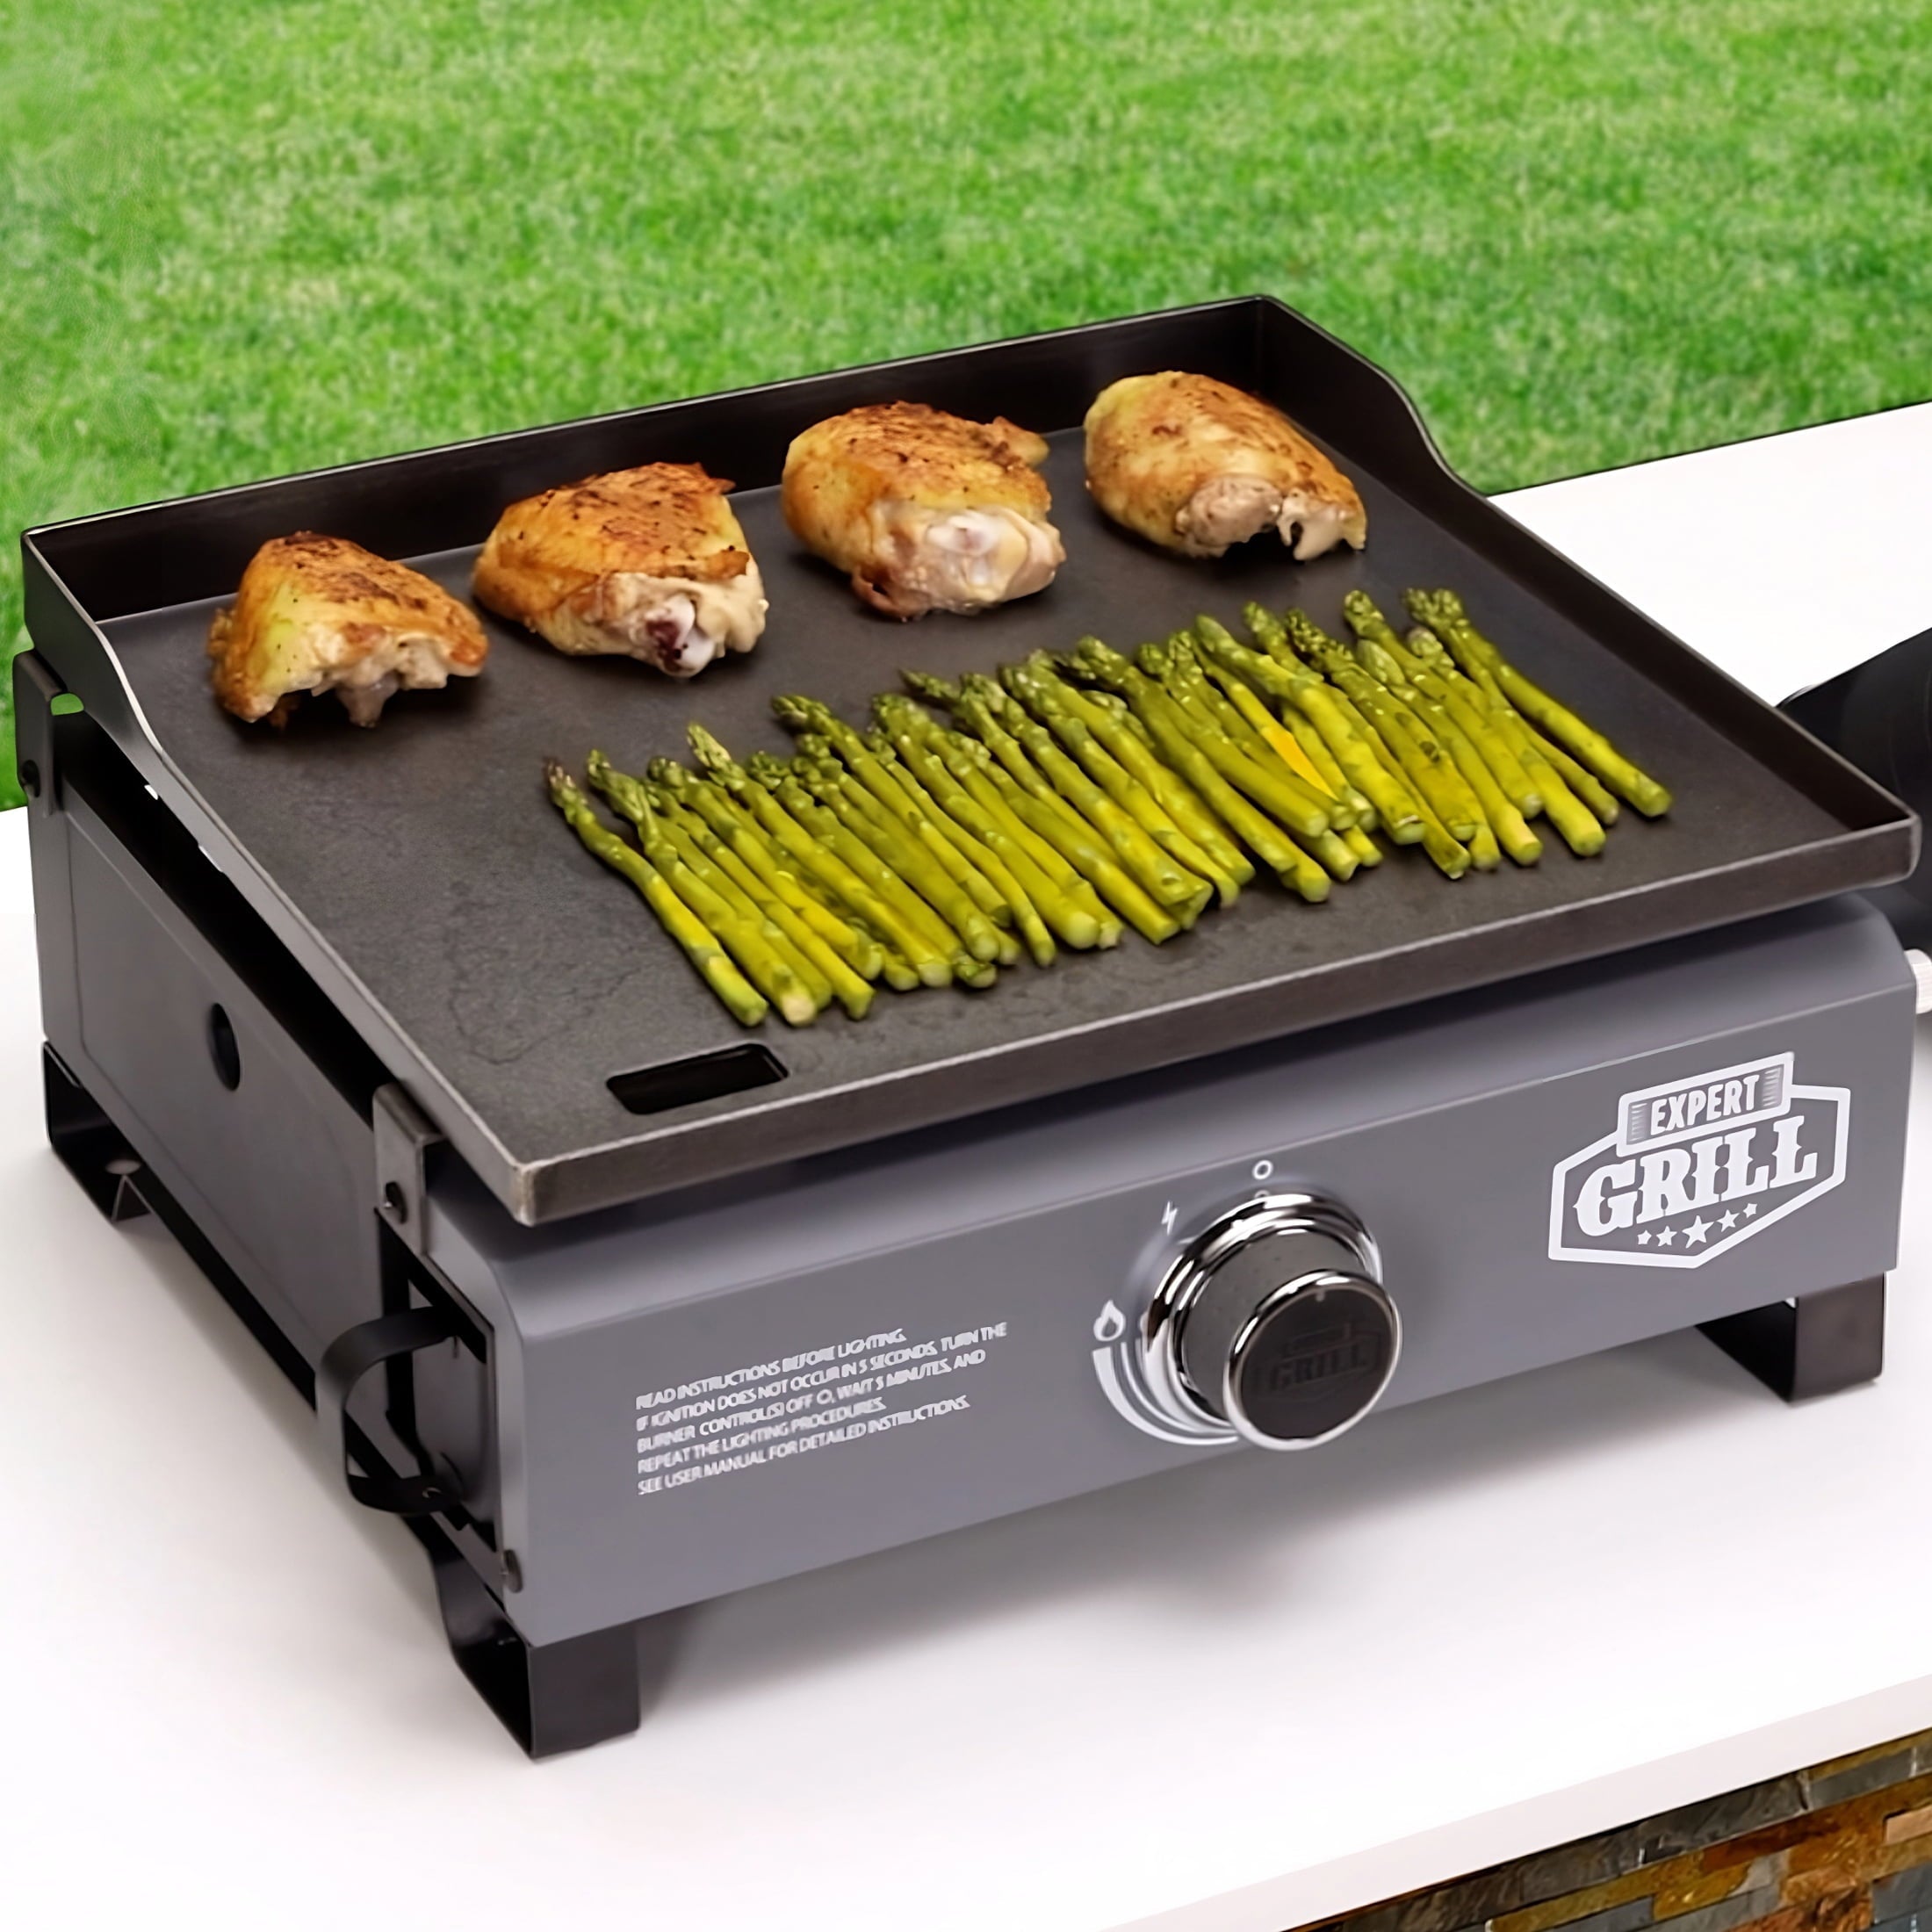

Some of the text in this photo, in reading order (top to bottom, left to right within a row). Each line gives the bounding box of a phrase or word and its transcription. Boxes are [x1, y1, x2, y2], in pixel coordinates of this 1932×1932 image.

[1650, 1074, 1759, 1135] EXPERT
[1573, 1115, 1818, 1236] GRILL
[636, 1388, 676, 1409] READ
[677, 1360, 781, 1400] INSTRUCTIONS
[638, 1425, 696, 1453] BURNER
[786, 1394, 813, 1413] OFF
[837, 1378, 874, 1400] WAIT
[954, 1349, 986, 1369] AND
[652, 1399, 715, 1426] IGNITION
[717, 1388, 756, 1410] DOES
[758, 1379, 788, 1399] NOT
[790, 1366, 840, 1391] OCCUR
[841, 1362, 856, 1377] IN
[941, 1330, 978, 1351] TURN
[979, 1322, 1007, 1340] THE
[638, 1446, 690, 1474] REPEAT
[693, 1439, 720, 1459] THE
[722, 1422, 789, 1452] LIGHTING
[638, 1476, 662, 1496] SEE
[665, 1466, 703, 1488] USER
[704, 1450, 766, 1474] MANUAL
[769, 1440, 797, 1460] FOR
[799, 1423, 866, 1453] DETAILED
